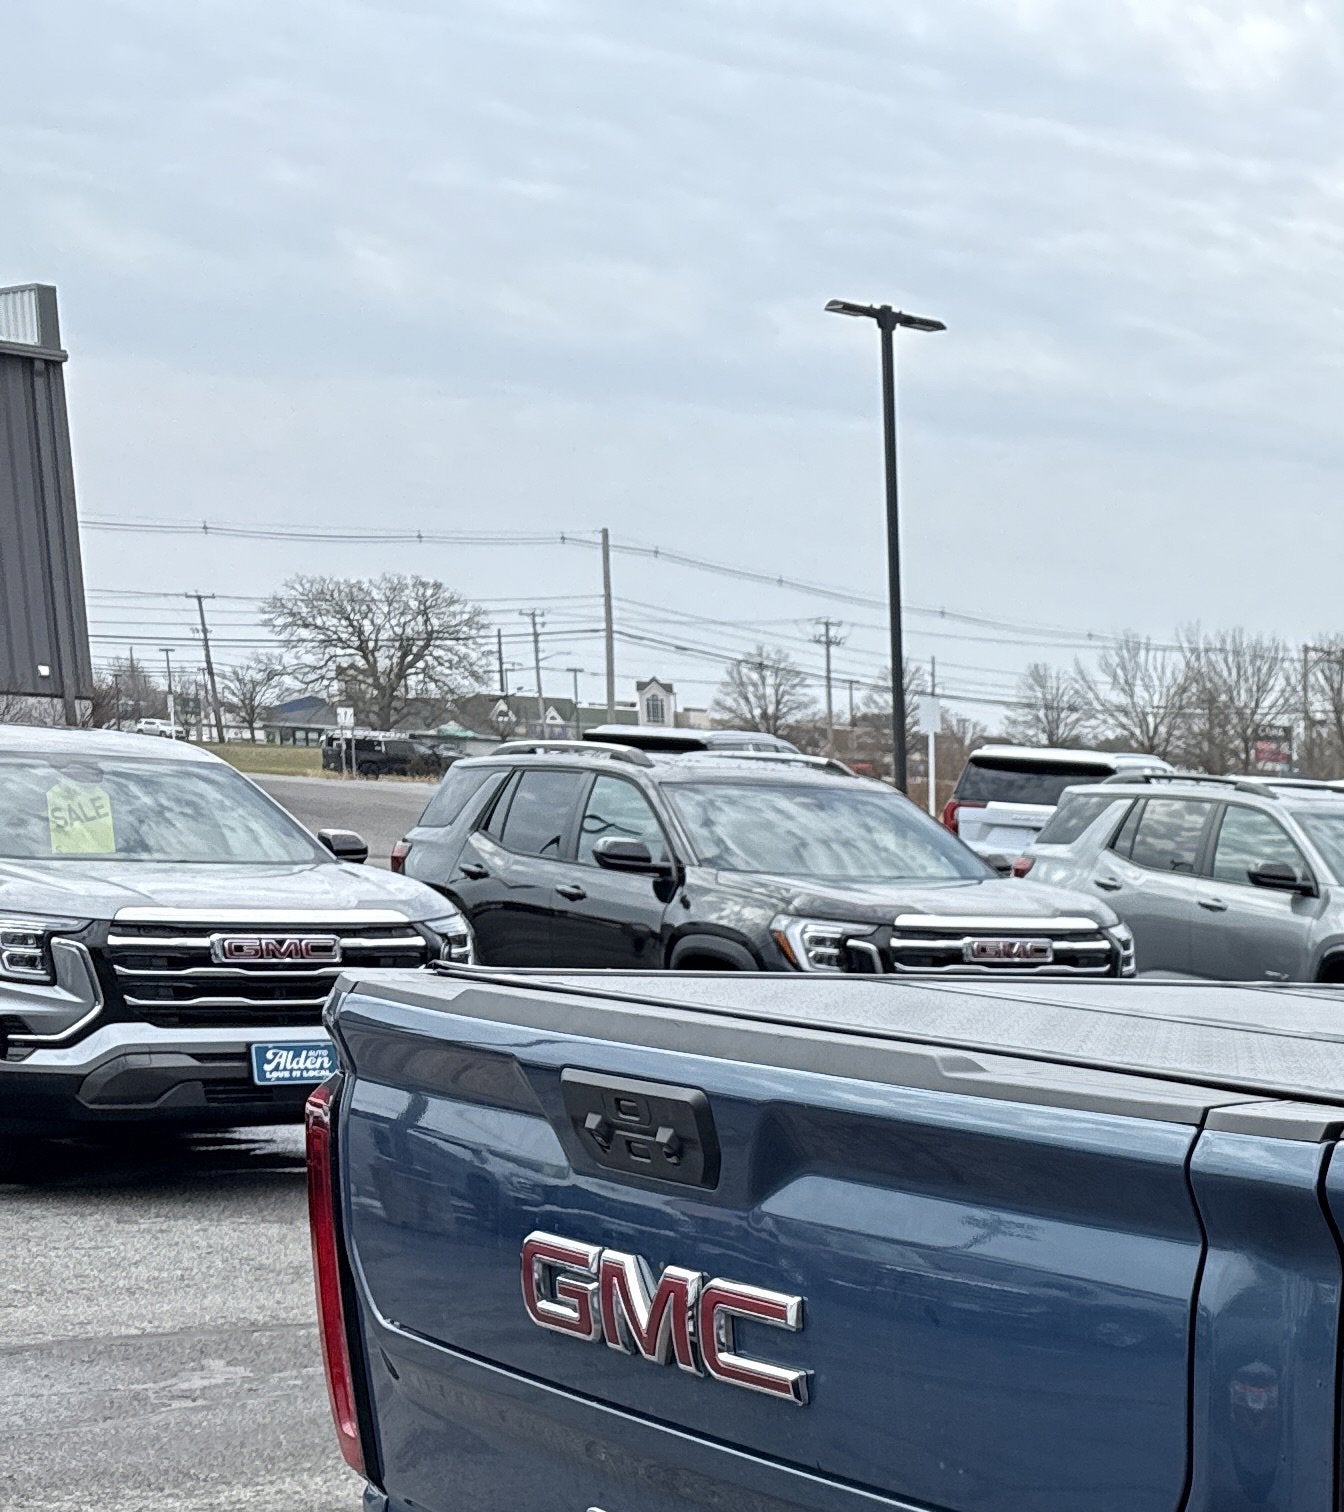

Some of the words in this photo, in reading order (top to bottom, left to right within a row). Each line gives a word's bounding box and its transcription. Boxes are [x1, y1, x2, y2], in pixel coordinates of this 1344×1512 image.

[51, 796, 109, 829] SALE
[224, 939, 336, 959] GMC
[974, 940, 1048, 959] GMC
[263, 1049, 332, 1071] Alden
[521, 1230, 815, 1406] GMC
